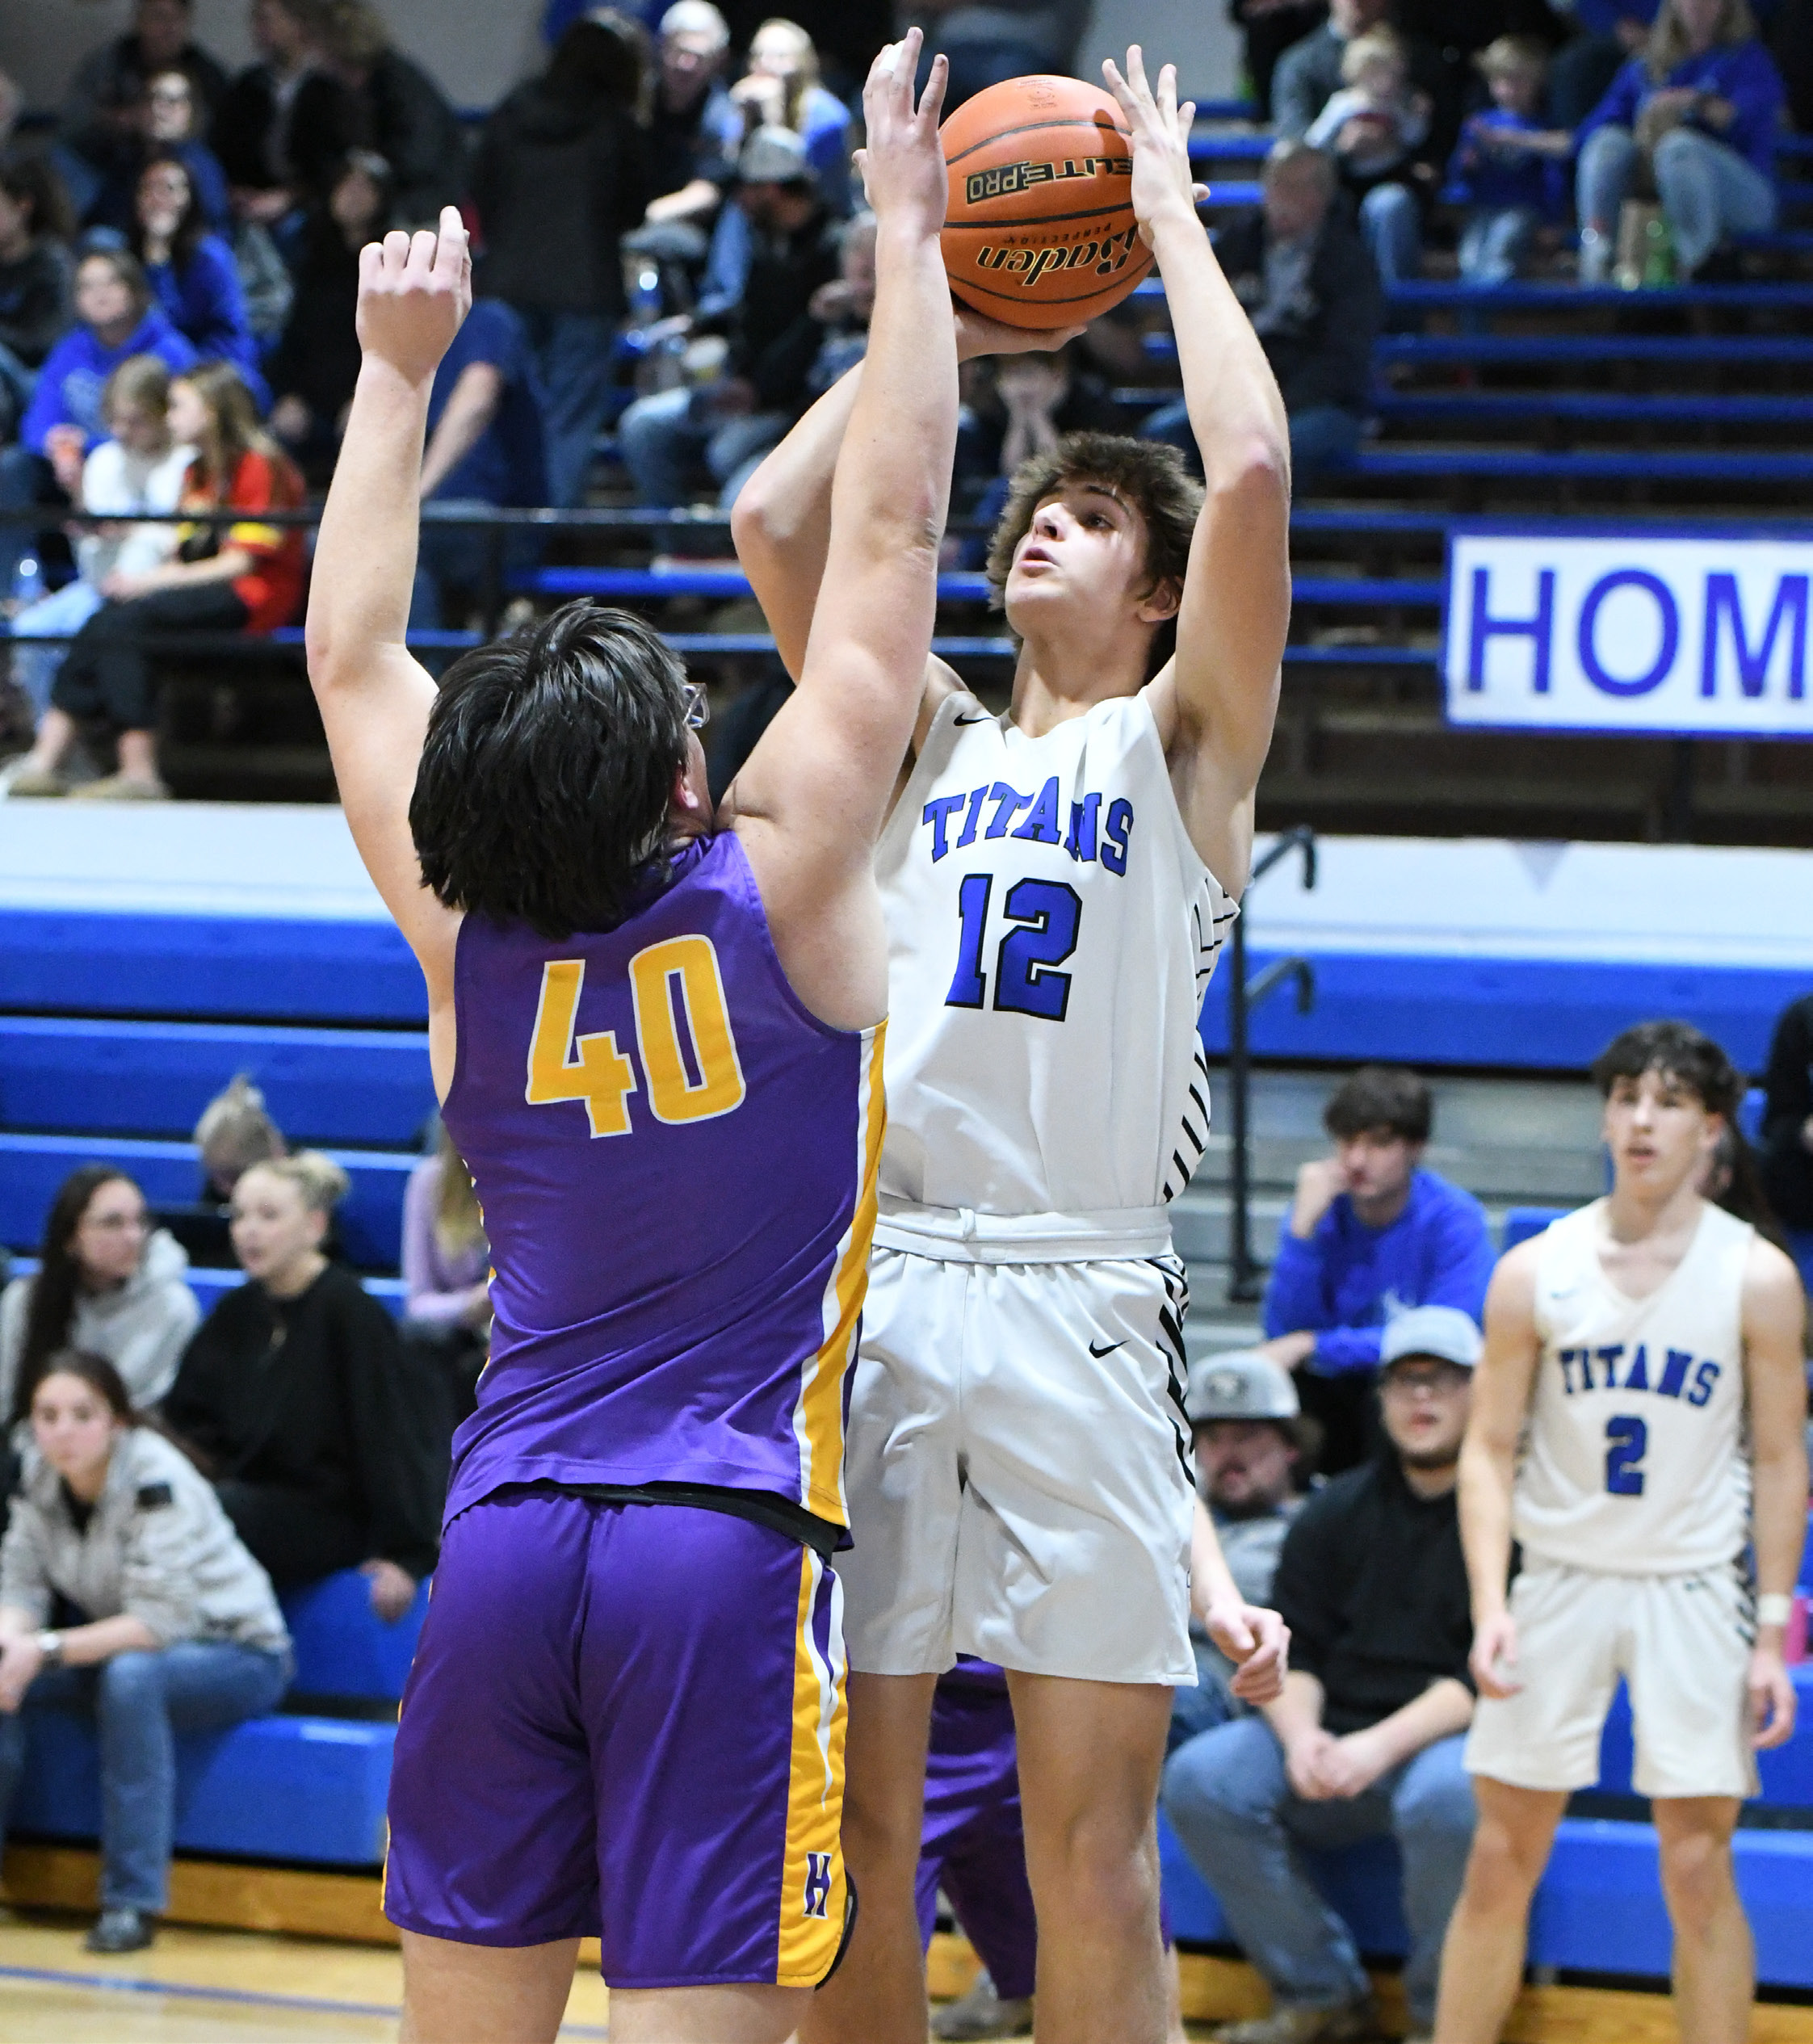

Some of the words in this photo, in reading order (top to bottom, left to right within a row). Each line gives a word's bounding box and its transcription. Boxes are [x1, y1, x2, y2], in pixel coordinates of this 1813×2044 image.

[976, 225, 1139, 286] Baden
[1004, 222, 1111, 245] PERFECTION
[1468, 567, 1810, 698] HOM
[922, 776, 1134, 877] TITANS
[944, 873, 1083, 1022] 12
[525, 934, 746, 1139] 40
[1559, 1344, 1721, 1407] TITANS
[1605, 1415, 1647, 1495] 2
[802, 1850, 833, 1920] H
